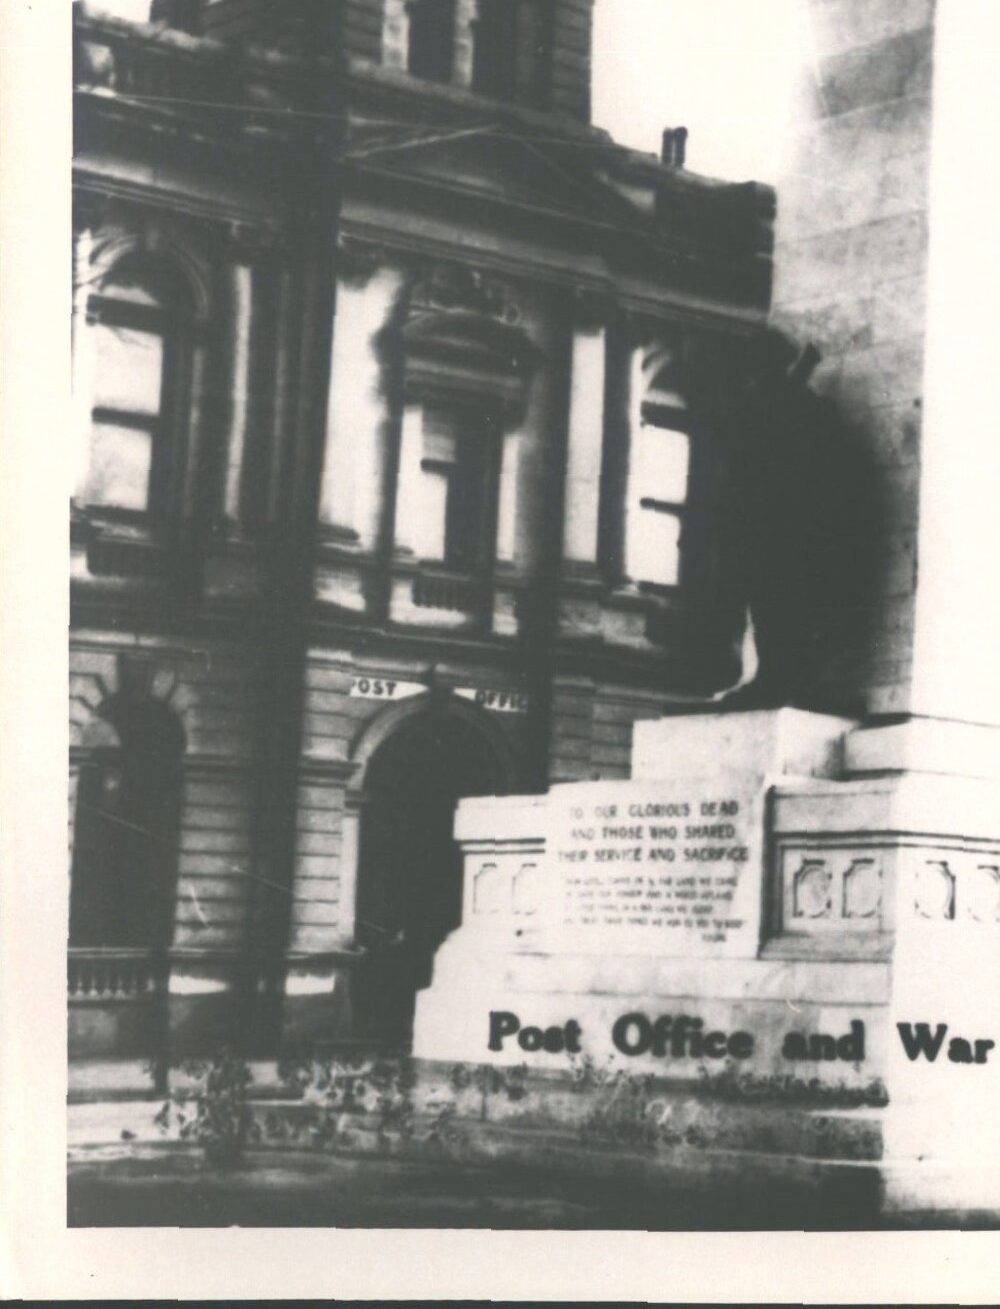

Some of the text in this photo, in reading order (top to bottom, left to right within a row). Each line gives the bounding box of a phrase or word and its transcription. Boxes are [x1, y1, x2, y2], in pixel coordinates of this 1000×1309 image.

[349, 678, 397, 696] OST
[628, 802, 690, 818] GLORIOUS
[700, 800, 739, 817] DEAD
[602, 825, 643, 839] THOSE
[649, 825, 677, 840] WHO
[685, 823, 735, 839] SHARED
[594, 847, 642, 862] SERVICE
[648, 848, 676, 862] AND
[683, 846, 748, 862] SACRIFICE
